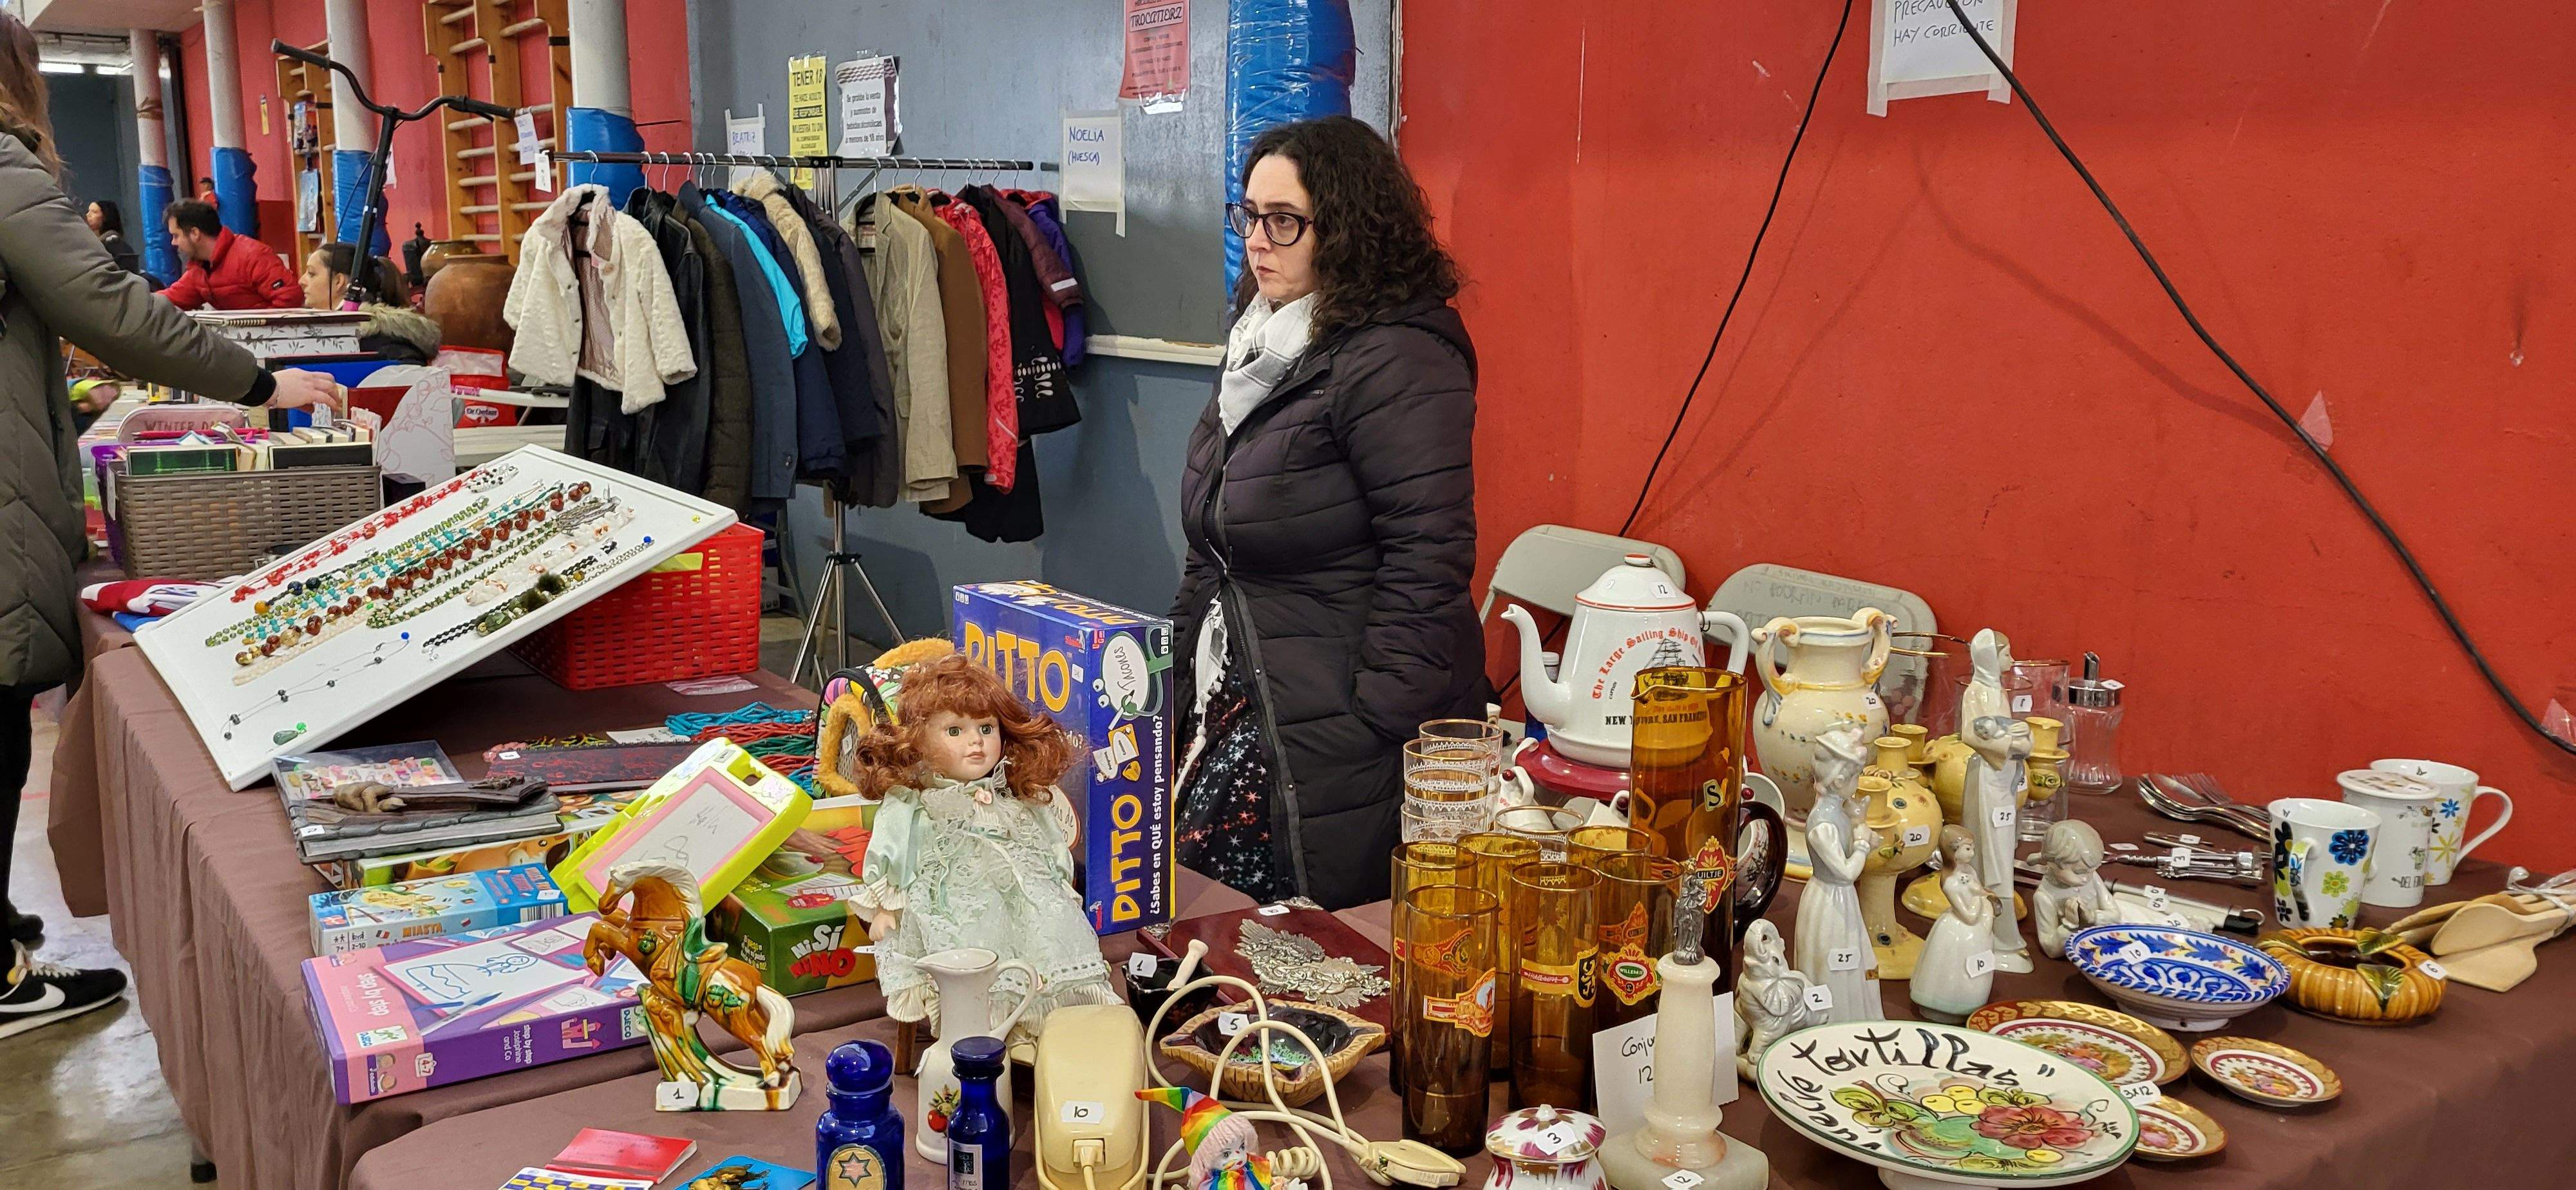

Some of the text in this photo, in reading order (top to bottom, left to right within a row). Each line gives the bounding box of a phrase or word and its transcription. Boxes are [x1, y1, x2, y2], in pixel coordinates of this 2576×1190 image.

[1893, 26, 1920, 48] HAY
[792, 68, 823, 87] TENER 18
[1069, 126, 1104, 142] NOELIA
[1068, 150, 1100, 165] (HUESCA)
[1658, 584, 1668, 594] 12
[965, 620, 1071, 713] DITTO
[1592, 677, 1605, 701] The
[1599, 647, 1625, 675] Large
[1668, 627, 1689, 641] Ship
[1605, 715, 1627, 725] NEW
[1663, 713, 1678, 724] SAN
[1707, 785, 1721, 807] S
[1150, 714, 1165, 914] ¿Sabes en QUÉ estoy pensando?
[2000, 811, 2012, 821] 25
[1909, 833, 1922, 842] 20
[1111, 794, 1142, 923] DITTO
[1698, 869, 1723, 879] UILTJE
[1838, 953, 1853, 963] 25
[2129, 949, 2141, 959] 10
[810, 947, 856, 978] NO
[1136, 959, 1143, 971] 1
[356, 972, 390, 1017] step by step
[1812, 994, 1823, 1003] 2
[623, 1009, 632, 1038] DJECO
[1230, 1018, 1240, 1030] 5
[523, 1025, 533, 1064] step by step
[504, 1050, 511, 1061] Co
[1639, 1065, 1654, 1084] 12
[673, 1088, 685, 1099] 1
[1074, 1106, 1088, 1118] 10
[1547, 1132, 1562, 1144] 3
[1674, 1176, 1692, 1184] 12
